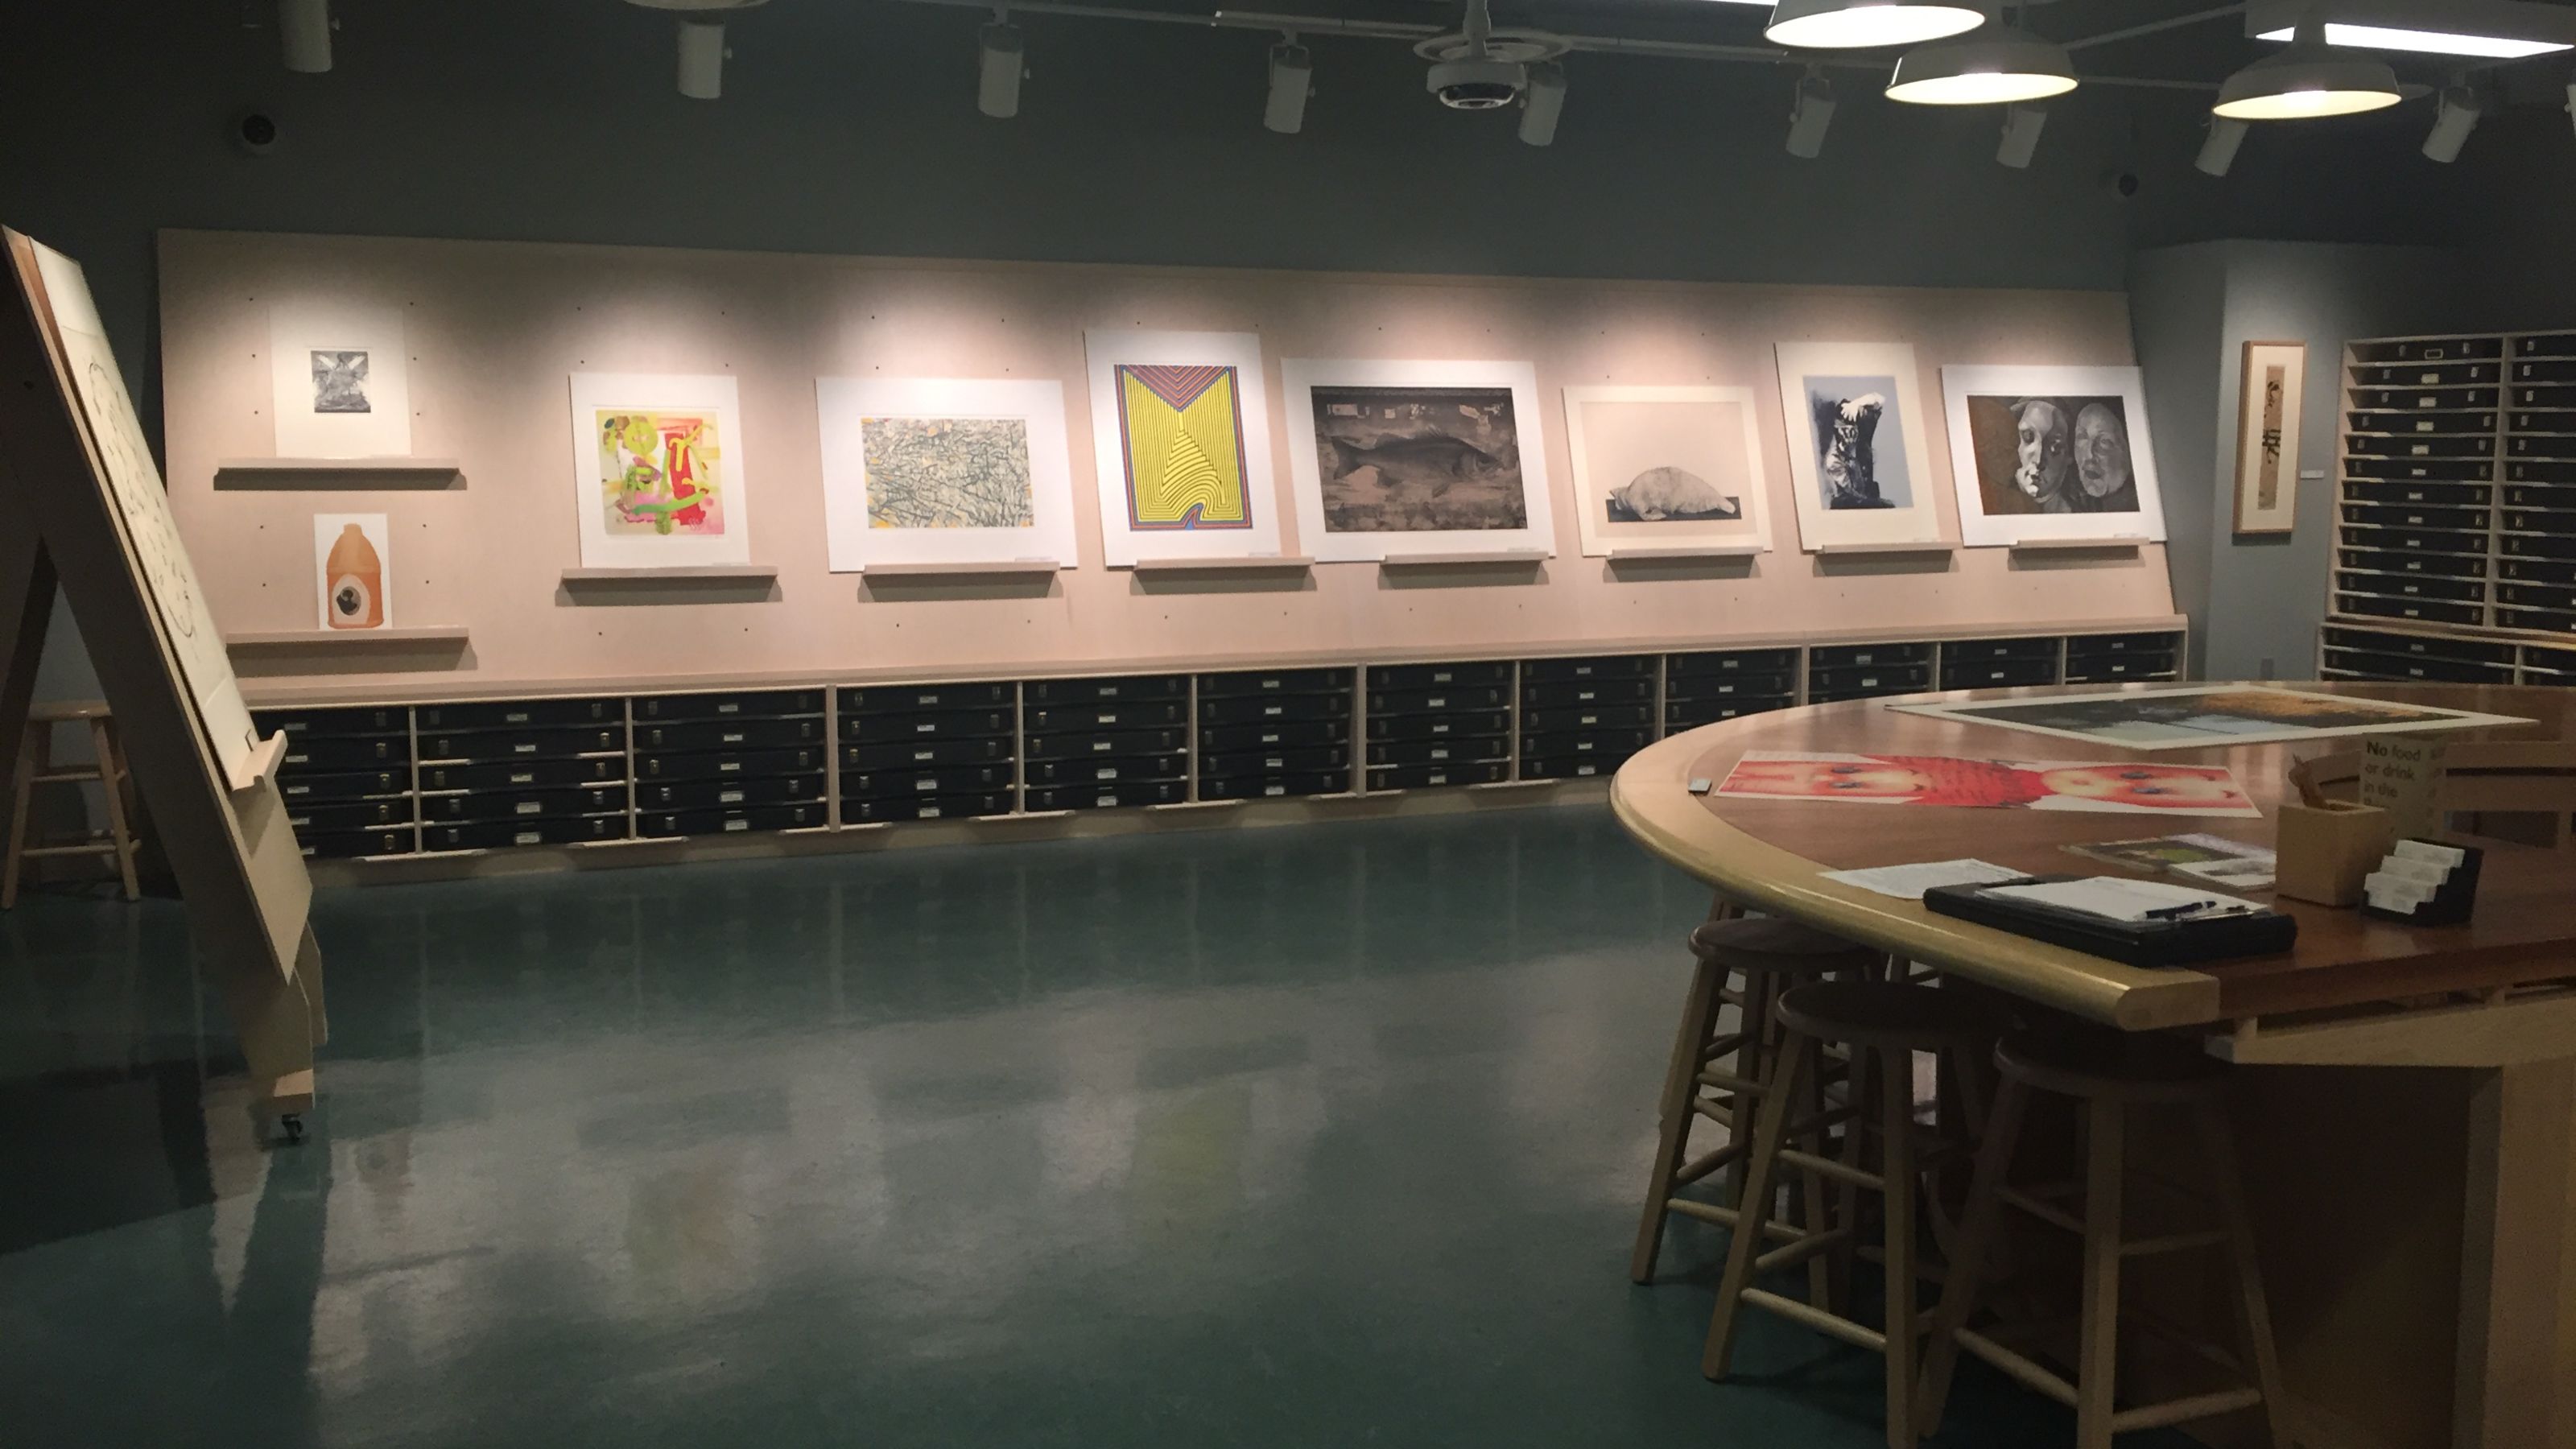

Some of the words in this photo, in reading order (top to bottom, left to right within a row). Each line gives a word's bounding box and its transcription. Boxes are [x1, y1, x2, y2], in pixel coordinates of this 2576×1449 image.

[2367, 741, 2388, 757] No
[2392, 745, 2421, 762] food
[2365, 763, 2379, 774] or
[2383, 763, 2415, 781] drink
[2364, 782, 2375, 792] in
[2378, 782, 2398, 798] the
